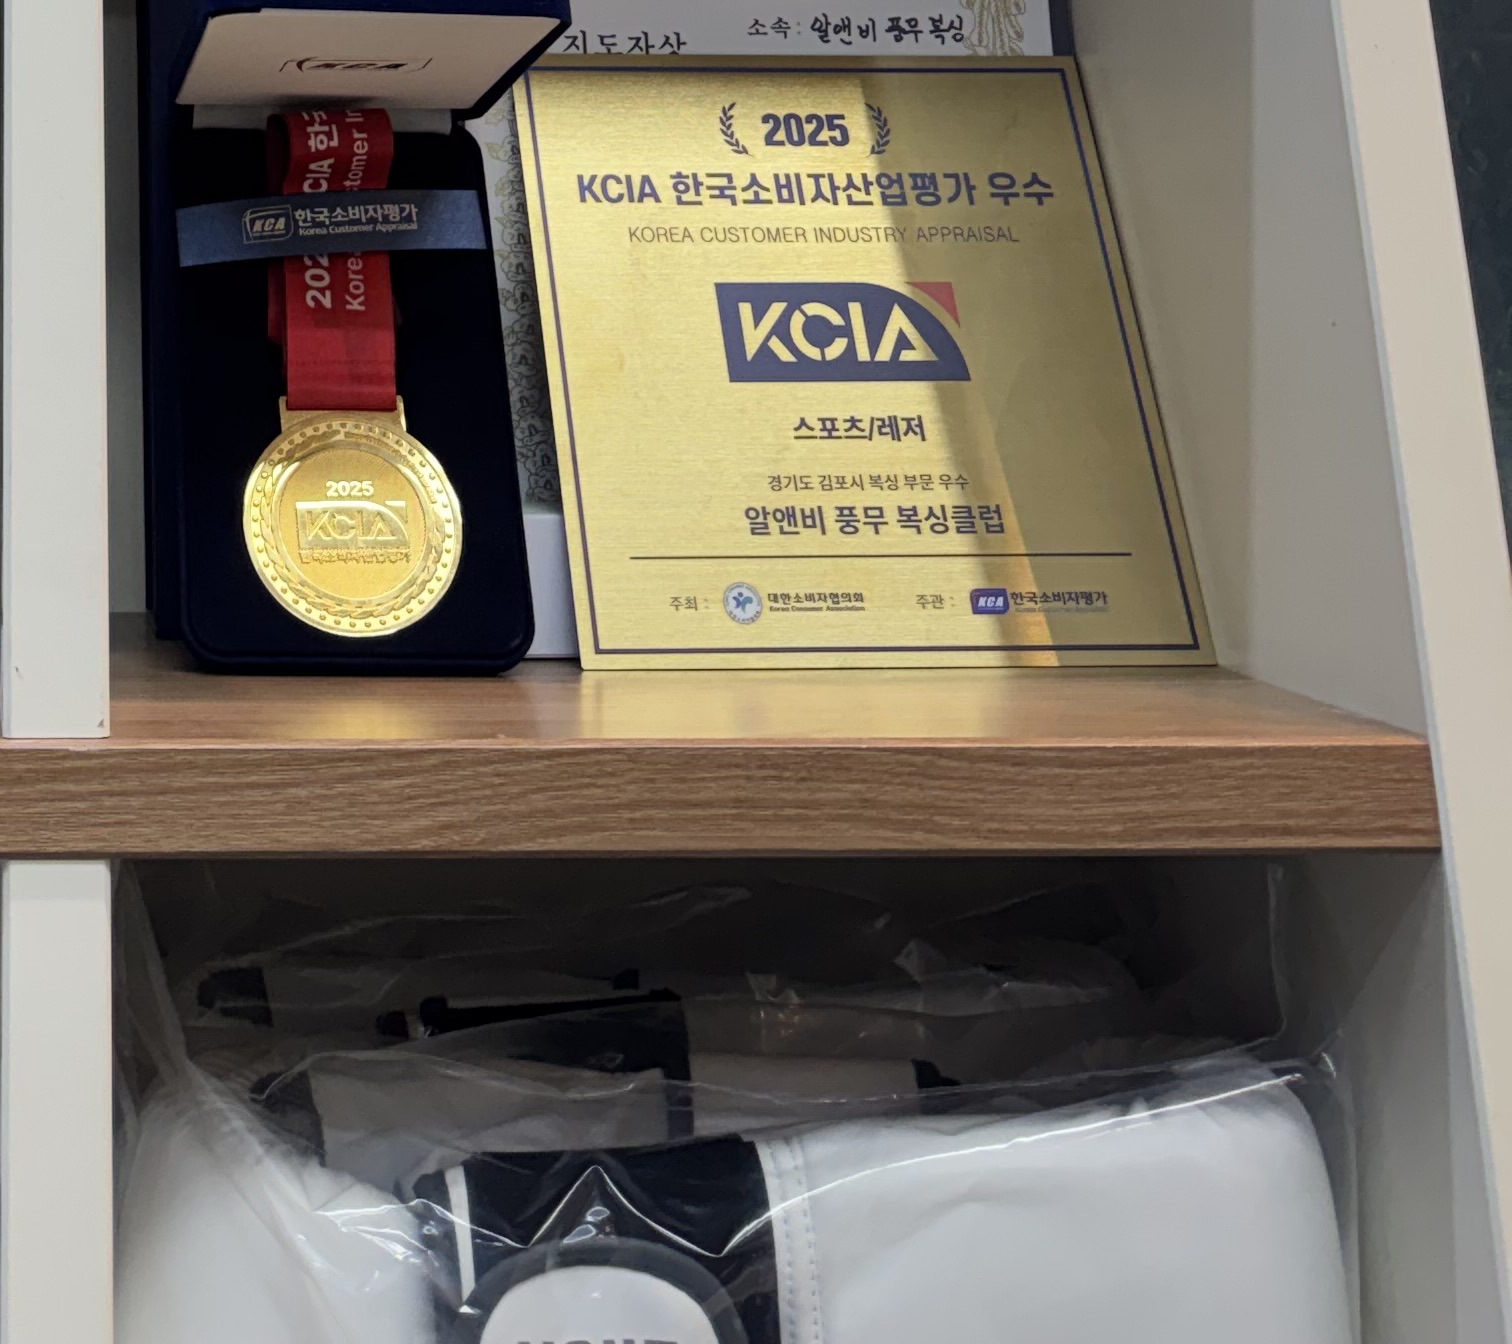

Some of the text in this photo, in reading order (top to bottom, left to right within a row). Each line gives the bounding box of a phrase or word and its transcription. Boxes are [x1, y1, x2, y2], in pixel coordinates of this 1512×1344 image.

[760, 112, 850, 147] 2025
[577, 171, 1054, 208] KCIA 한국소비자산업평가 우수
[252, 203, 418, 234] KCA 한국소비자평가
[299, 221, 418, 236] Korea Customer Appraisal
[628, 226, 1020, 245] KOREA CUSTOMER INDUSTRY APPRAISAL
[737, 300, 940, 363] KCIA
[792, 415, 927, 443] 스포츠/레저
[325, 480, 375, 497] 2025
[767, 472, 969, 493] 경기도 김포시 복싱 부문 우수
[306, 509, 398, 542] KCIA
[743, 504, 1005, 537] 알앤비 풍무 복싱클럽
[668, 595, 699, 611] 주최
[915, 593, 946, 610] 주관
[977, 595, 1005, 609] KCA
[1010, 590, 1108, 606] 한국소비자평가
